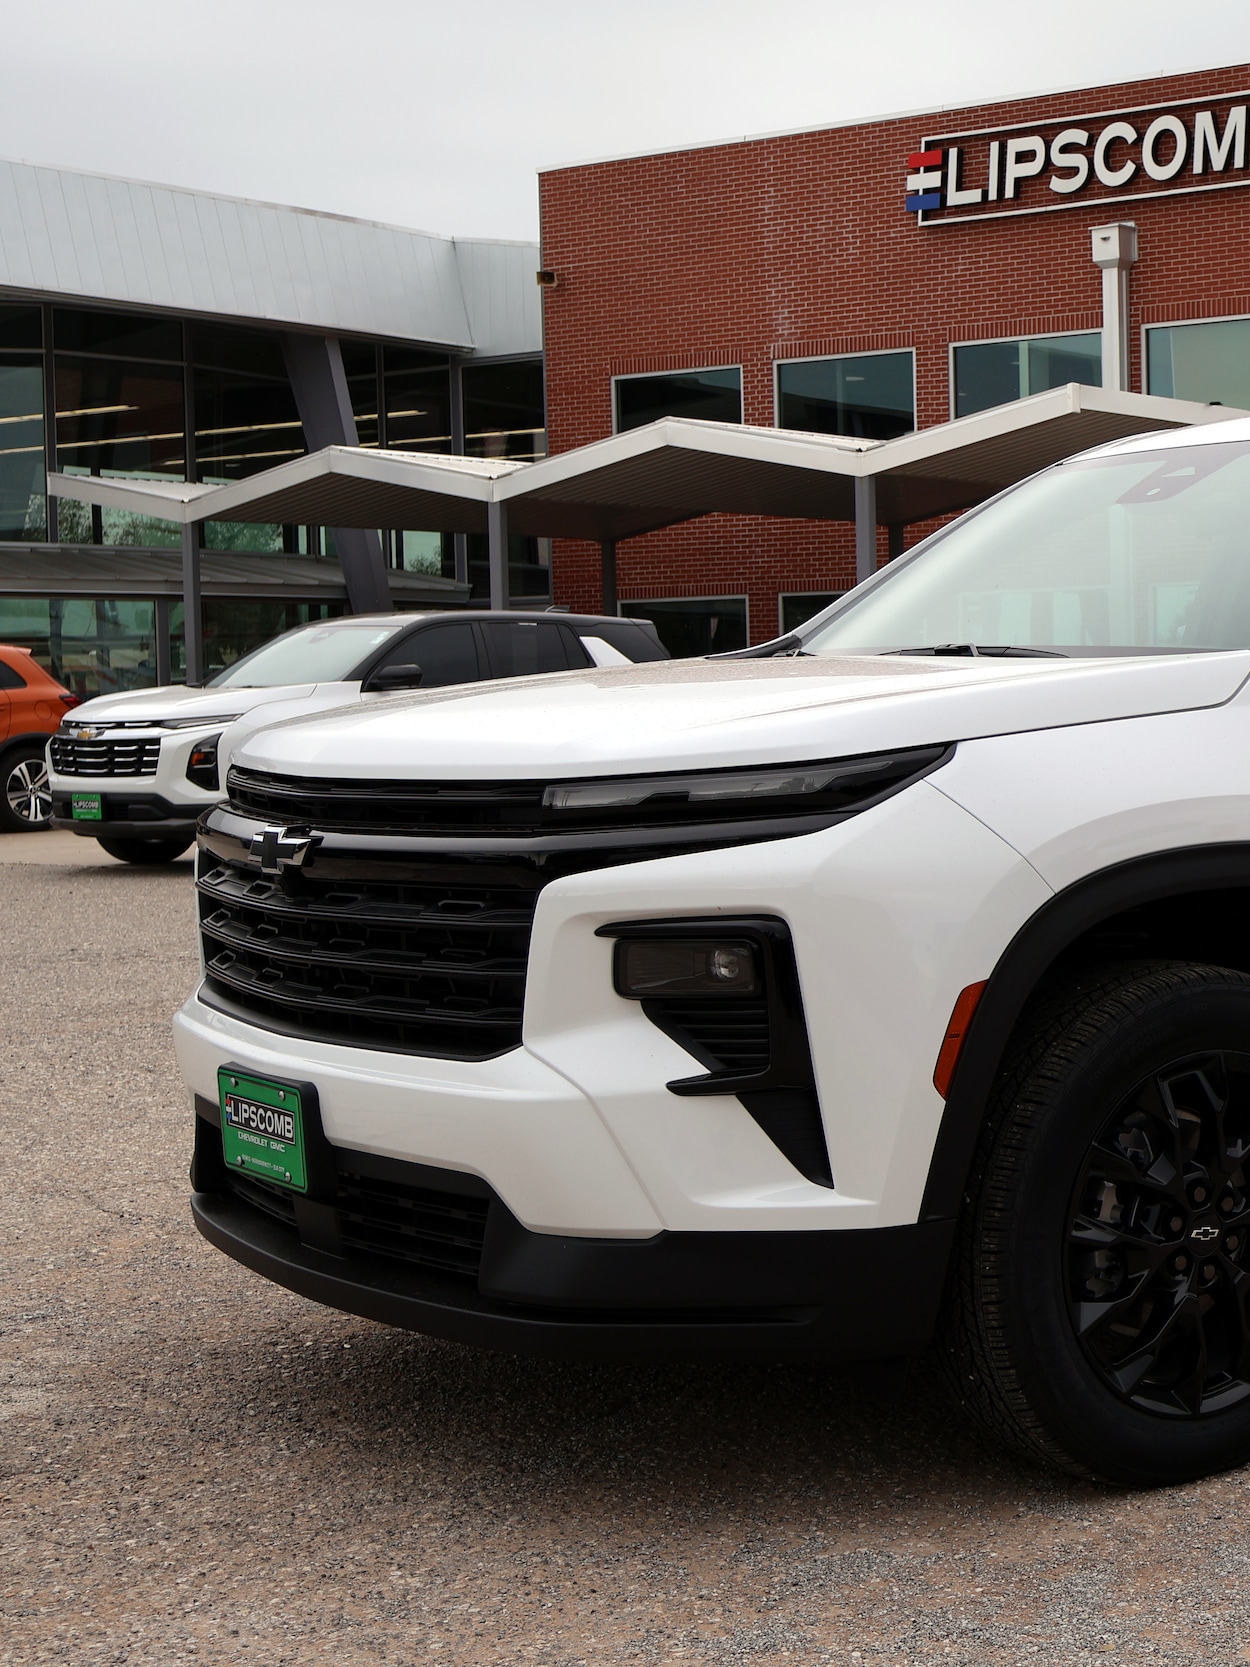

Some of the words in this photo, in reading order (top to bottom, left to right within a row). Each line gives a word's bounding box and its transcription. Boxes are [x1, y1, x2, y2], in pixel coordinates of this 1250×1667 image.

[231, 1100, 294, 1139] LIPSCOMB
[238, 1131, 268, 1147] CHEVROLET
[270, 1141, 286, 1152] GMC
